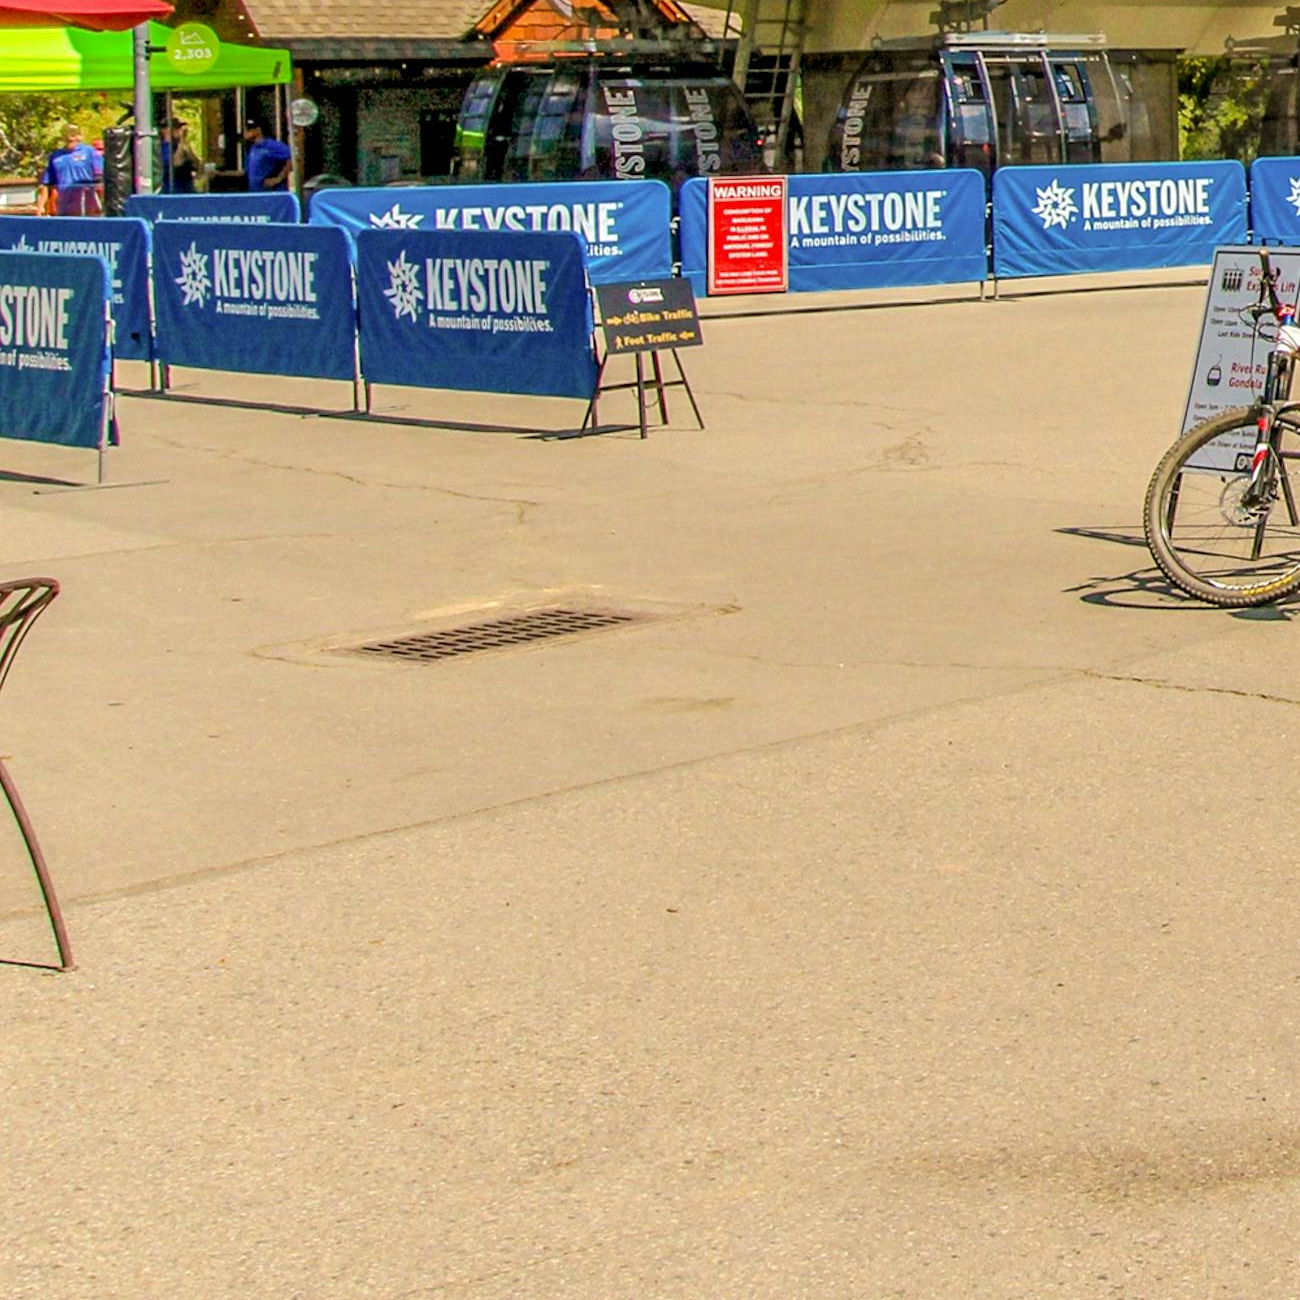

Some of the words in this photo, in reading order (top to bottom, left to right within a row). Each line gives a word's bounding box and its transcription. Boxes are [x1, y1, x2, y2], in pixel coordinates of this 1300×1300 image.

[174, 48, 212, 60] 2,303
[603, 86, 645, 179] YSTONE
[683, 85, 720, 175] STONE
[841, 81, 872, 171] YSTONE
[714, 185, 782, 197] WARNING
[1083, 178, 1210, 219] KEYSTONE
[789, 190, 942, 235] KEYSTONE
[436, 202, 618, 243] KEYSTONE
[1084, 222, 1091, 231] A
[1093, 219, 1139, 230] mountain
[1141, 218, 1151, 228] of
[1153, 215, 1213, 229] possibilities.
[791, 237, 799, 248] A
[802, 234, 857, 247] mountain
[860, 233, 872, 244] of
[875, 229, 946, 246] possibilities.
[214, 250, 317, 302] KEYSTONE
[426, 258, 548, 314] KEYSTONE
[1281, 281, 1295, 293] Lift
[0, 284, 69, 349] STONE
[216, 304, 223, 313] A
[224, 304, 257, 315] mountain
[259, 304, 266, 315] of
[267, 304, 320, 319] possibilities.
[639, 312, 660, 322] Bike
[662, 309, 693, 320] Traffic
[429, 314, 436, 326] A
[437, 315, 480, 330] mountain
[482, 315, 491, 330] of
[493, 315, 554, 333] possibilities.
[624, 335, 645, 346] Foot
[646, 331, 678, 343] Traffic
[1231, 362, 1252, 375] River
[1255, 364, 1266, 375] Ru
[1229, 376, 1262, 389] Gondola
